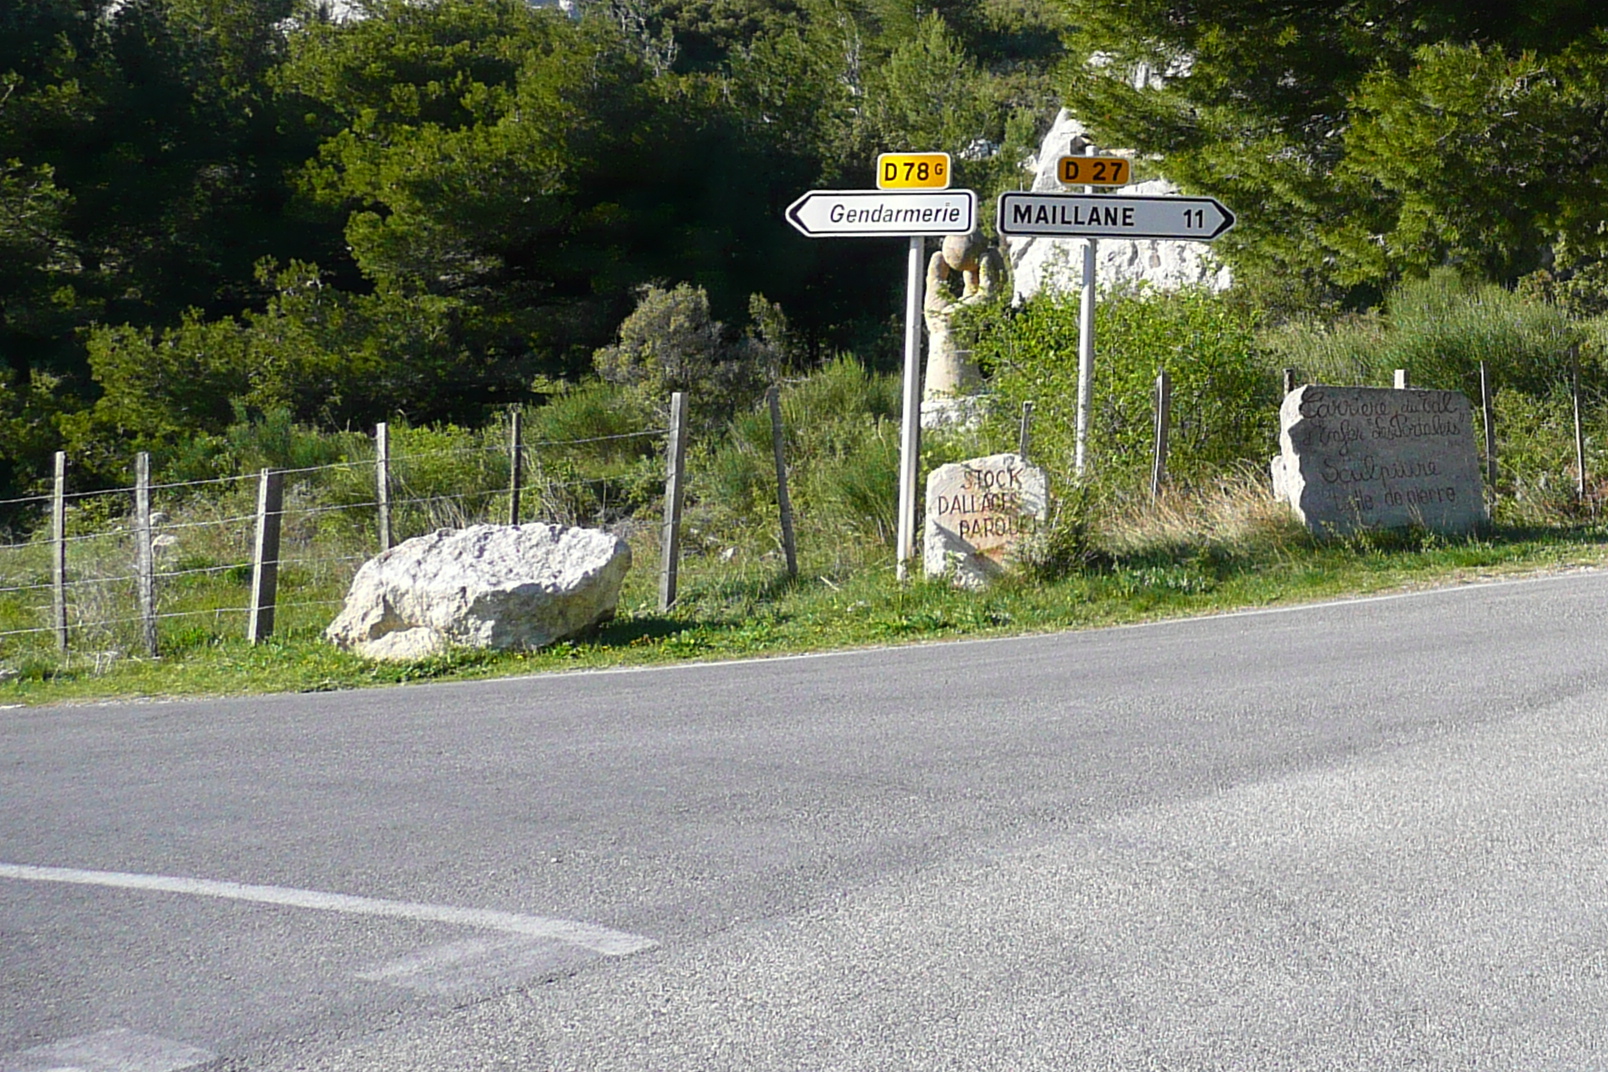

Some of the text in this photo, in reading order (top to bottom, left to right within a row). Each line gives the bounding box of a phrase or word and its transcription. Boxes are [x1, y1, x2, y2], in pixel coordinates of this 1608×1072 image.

[1092, 162, 1122, 181] 27
[829, 203, 961, 224] Gendarmerie
[1012, 203, 1204, 229] MAILLANE 11
[960, 468, 1024, 490] STOCK
[1384, 488, 1404, 507] de
